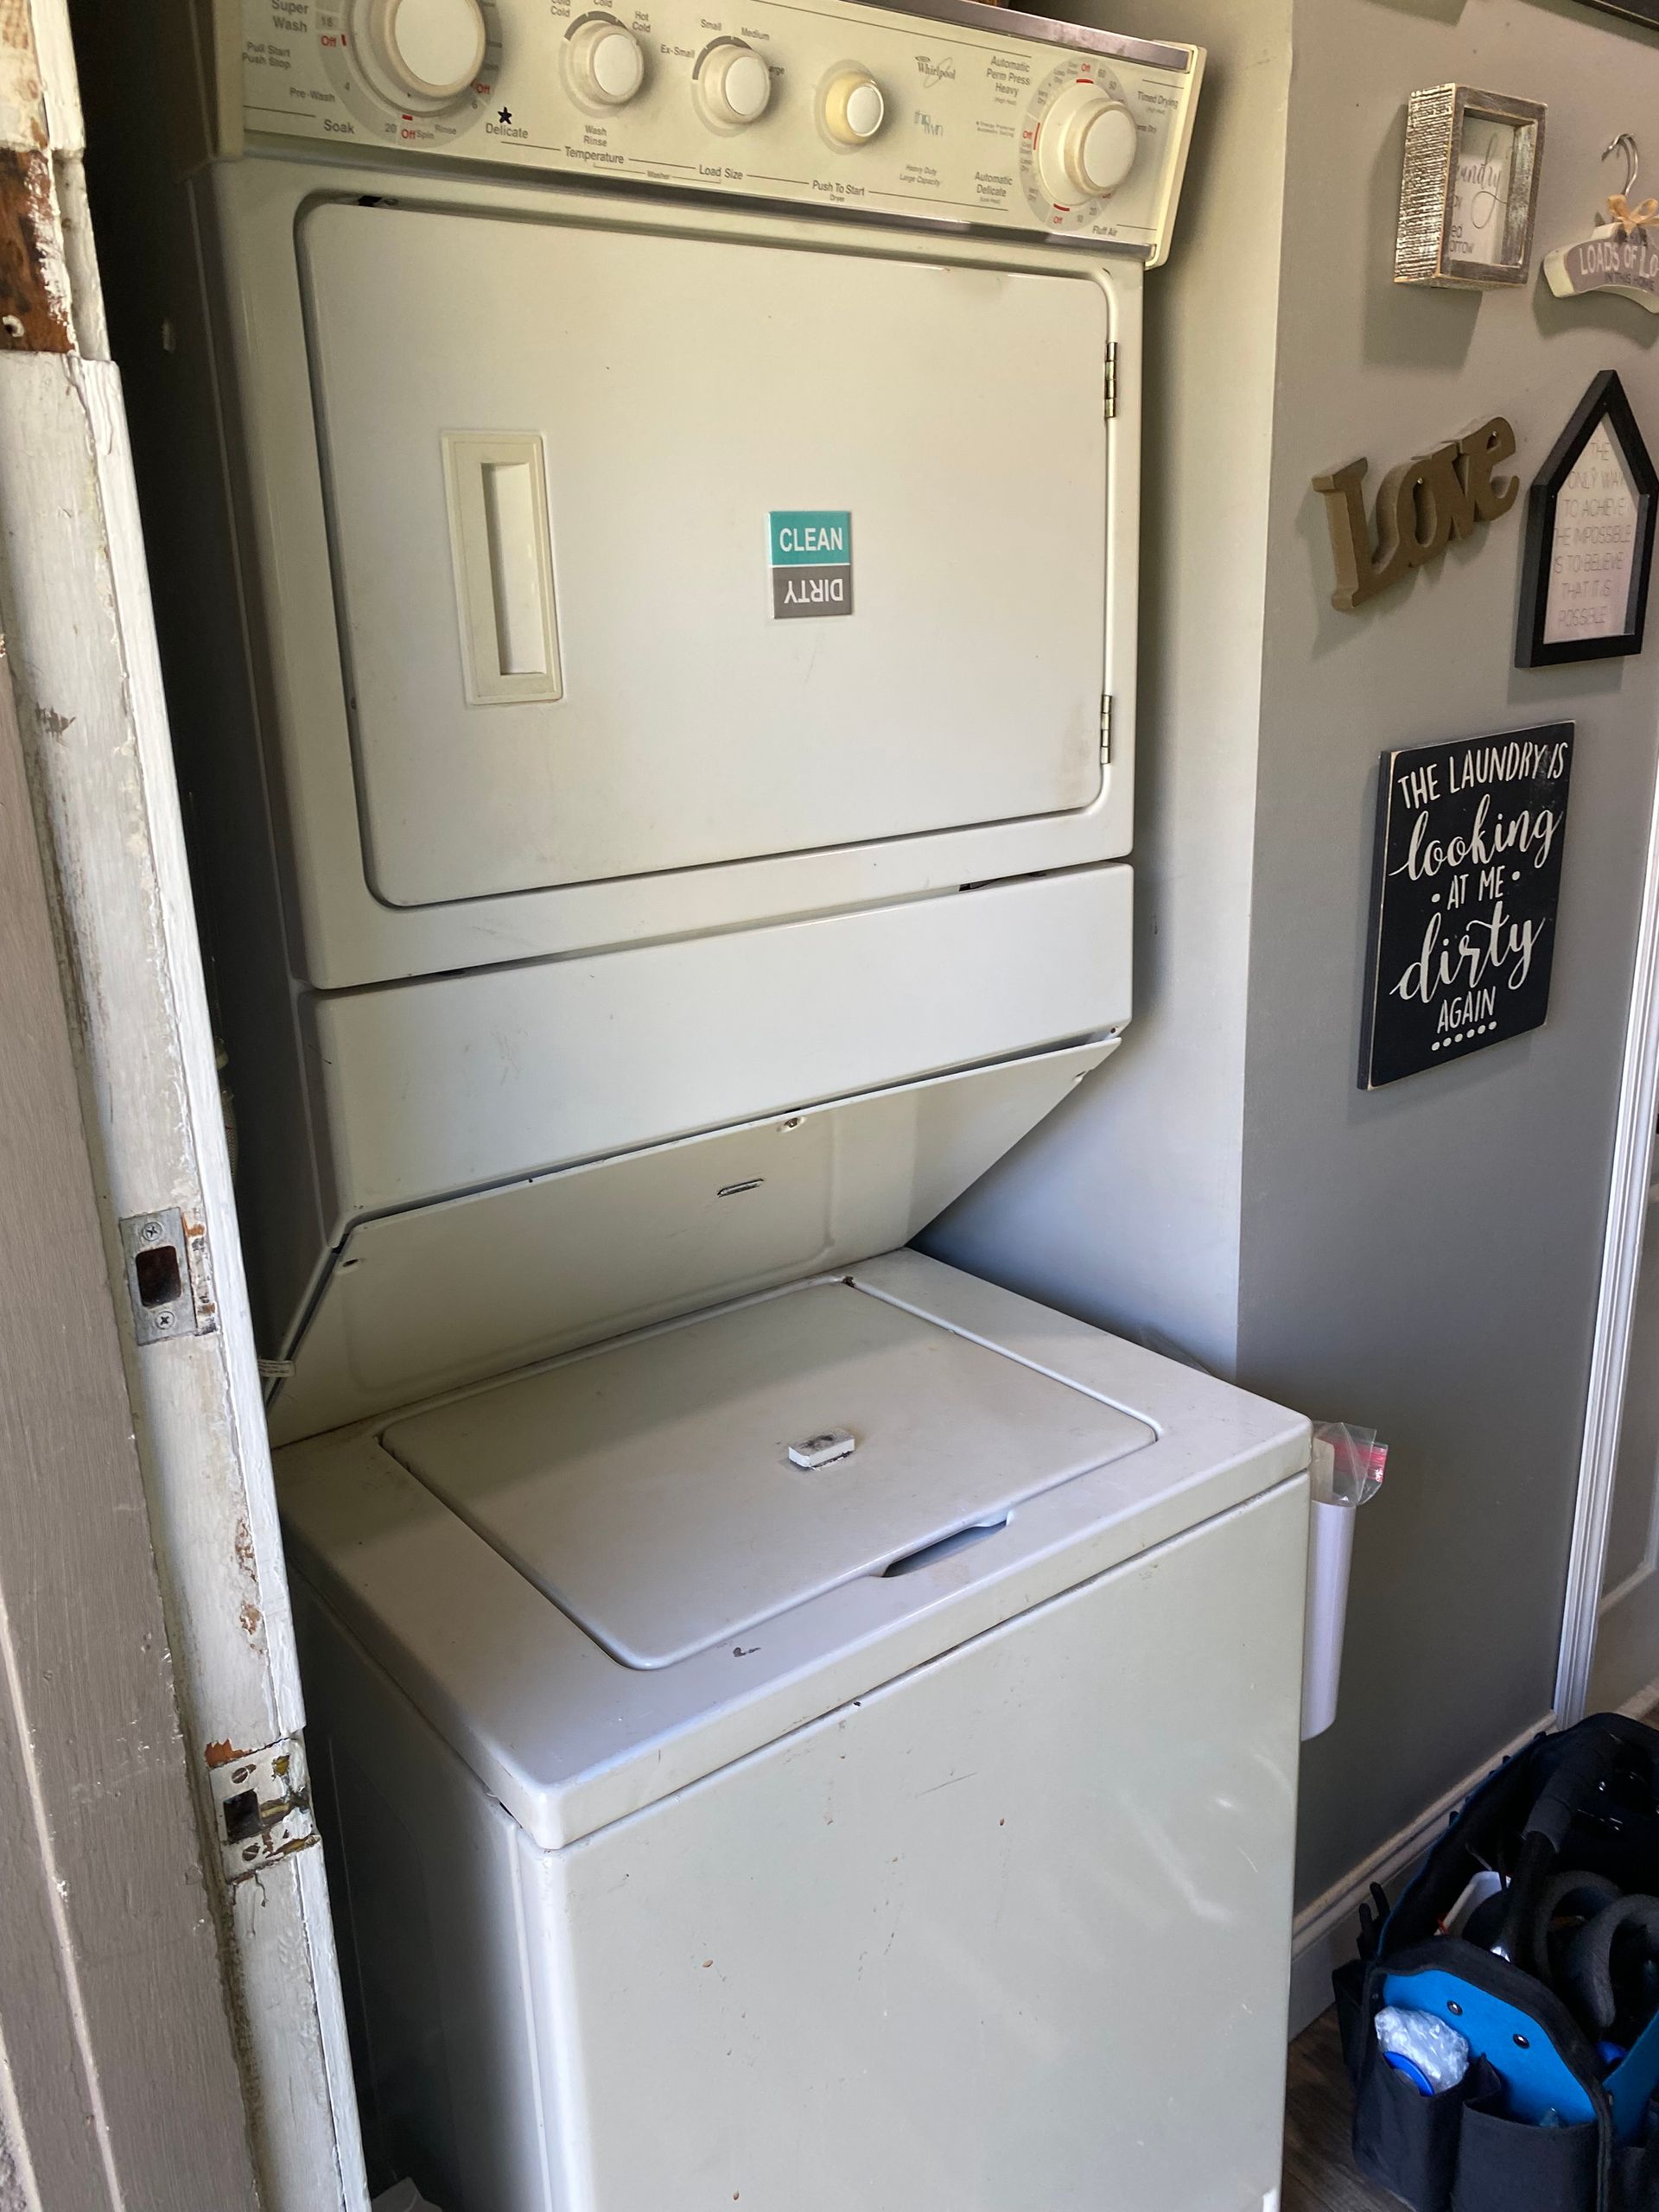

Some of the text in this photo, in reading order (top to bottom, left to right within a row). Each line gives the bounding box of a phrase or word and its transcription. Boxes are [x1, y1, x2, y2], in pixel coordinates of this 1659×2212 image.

[271, 0, 308, 15] Super
[550, 5, 570, 17] Cold
[272, 16, 308, 33] Wash
[632, 21, 651, 33] Cold
[701, 19, 721, 31] Small
[321, 35, 337, 48] Off
[741, 27, 770, 41] Medium
[241, 52, 266, 65] Push
[660, 43, 695, 59] Ex-Small
[768, 65, 785, 76] arge
[917, 60, 957, 80] Whirlpool
[990, 55, 1030, 73] Automatic
[1007, 72, 1030, 86] Press
[995, 82, 1019, 98] Heavy
[323, 118, 354, 135] Soak
[486, 123, 530, 139] Delicate
[585, 124, 607, 137] Wash
[583, 135, 607, 147] Rinse
[564, 145, 625, 164] Temperature
[699, 164, 744, 181] Load Size
[974, 171, 1014, 187] Automatic
[811, 179, 865, 197] Push To Start
[976, 183, 1007, 198] Delicate
[1579, 241, 1620, 276] LOADS
[1624, 244, 1637, 270] OF
[1312, 416, 1520, 609] LOVE
[779, 527, 843, 553] CLEAN
[784, 578, 844, 604] DIRTY
[1396, 741, 1569, 810] THE LAUNDRY IS
[1388, 793, 1564, 881] looking
[1446, 864, 1506, 911] AT ME
[1389, 899, 1547, 1004] dirty
[1436, 985, 1497, 1034] AGAIN
